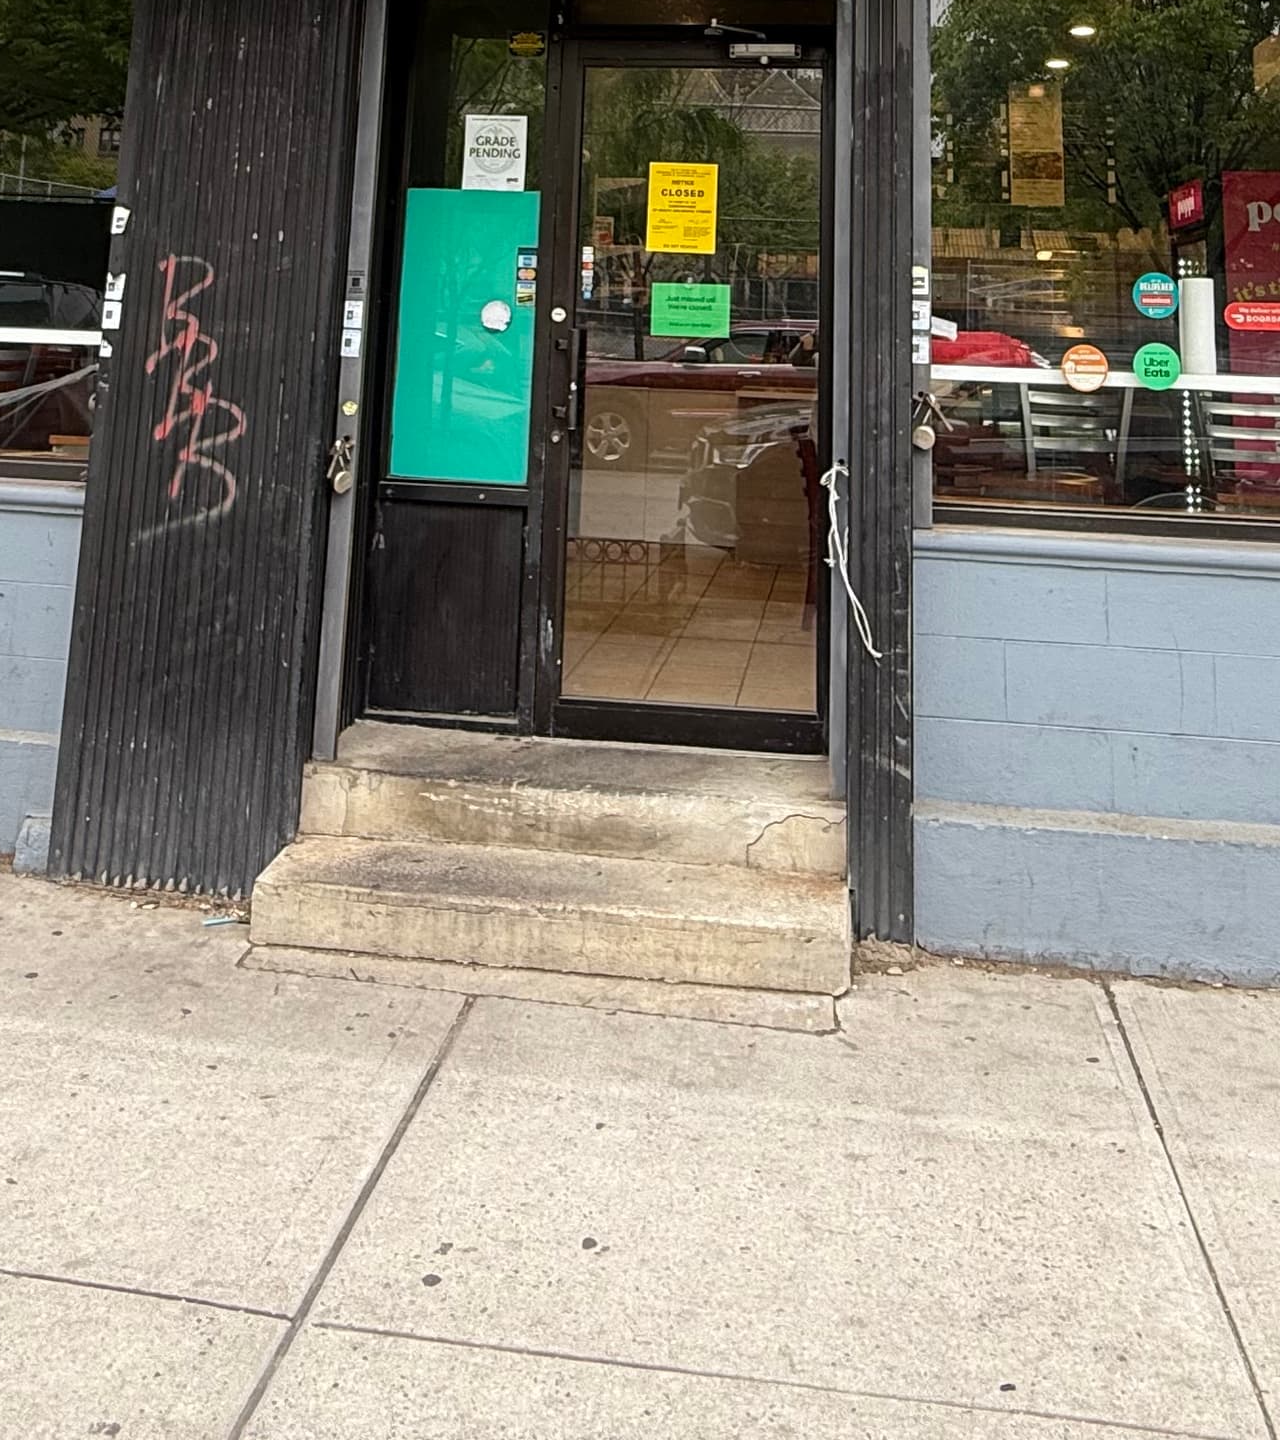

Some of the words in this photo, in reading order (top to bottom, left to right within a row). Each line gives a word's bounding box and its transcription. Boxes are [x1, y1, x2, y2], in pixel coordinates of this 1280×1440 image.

[475, 135, 516, 147] GRADE
[469, 147, 522, 159] PENDING
[660, 188, 705, 198] CLOSED
[1144, 357, 1169, 368] Uber
[1144, 367, 1171, 378] Eats
